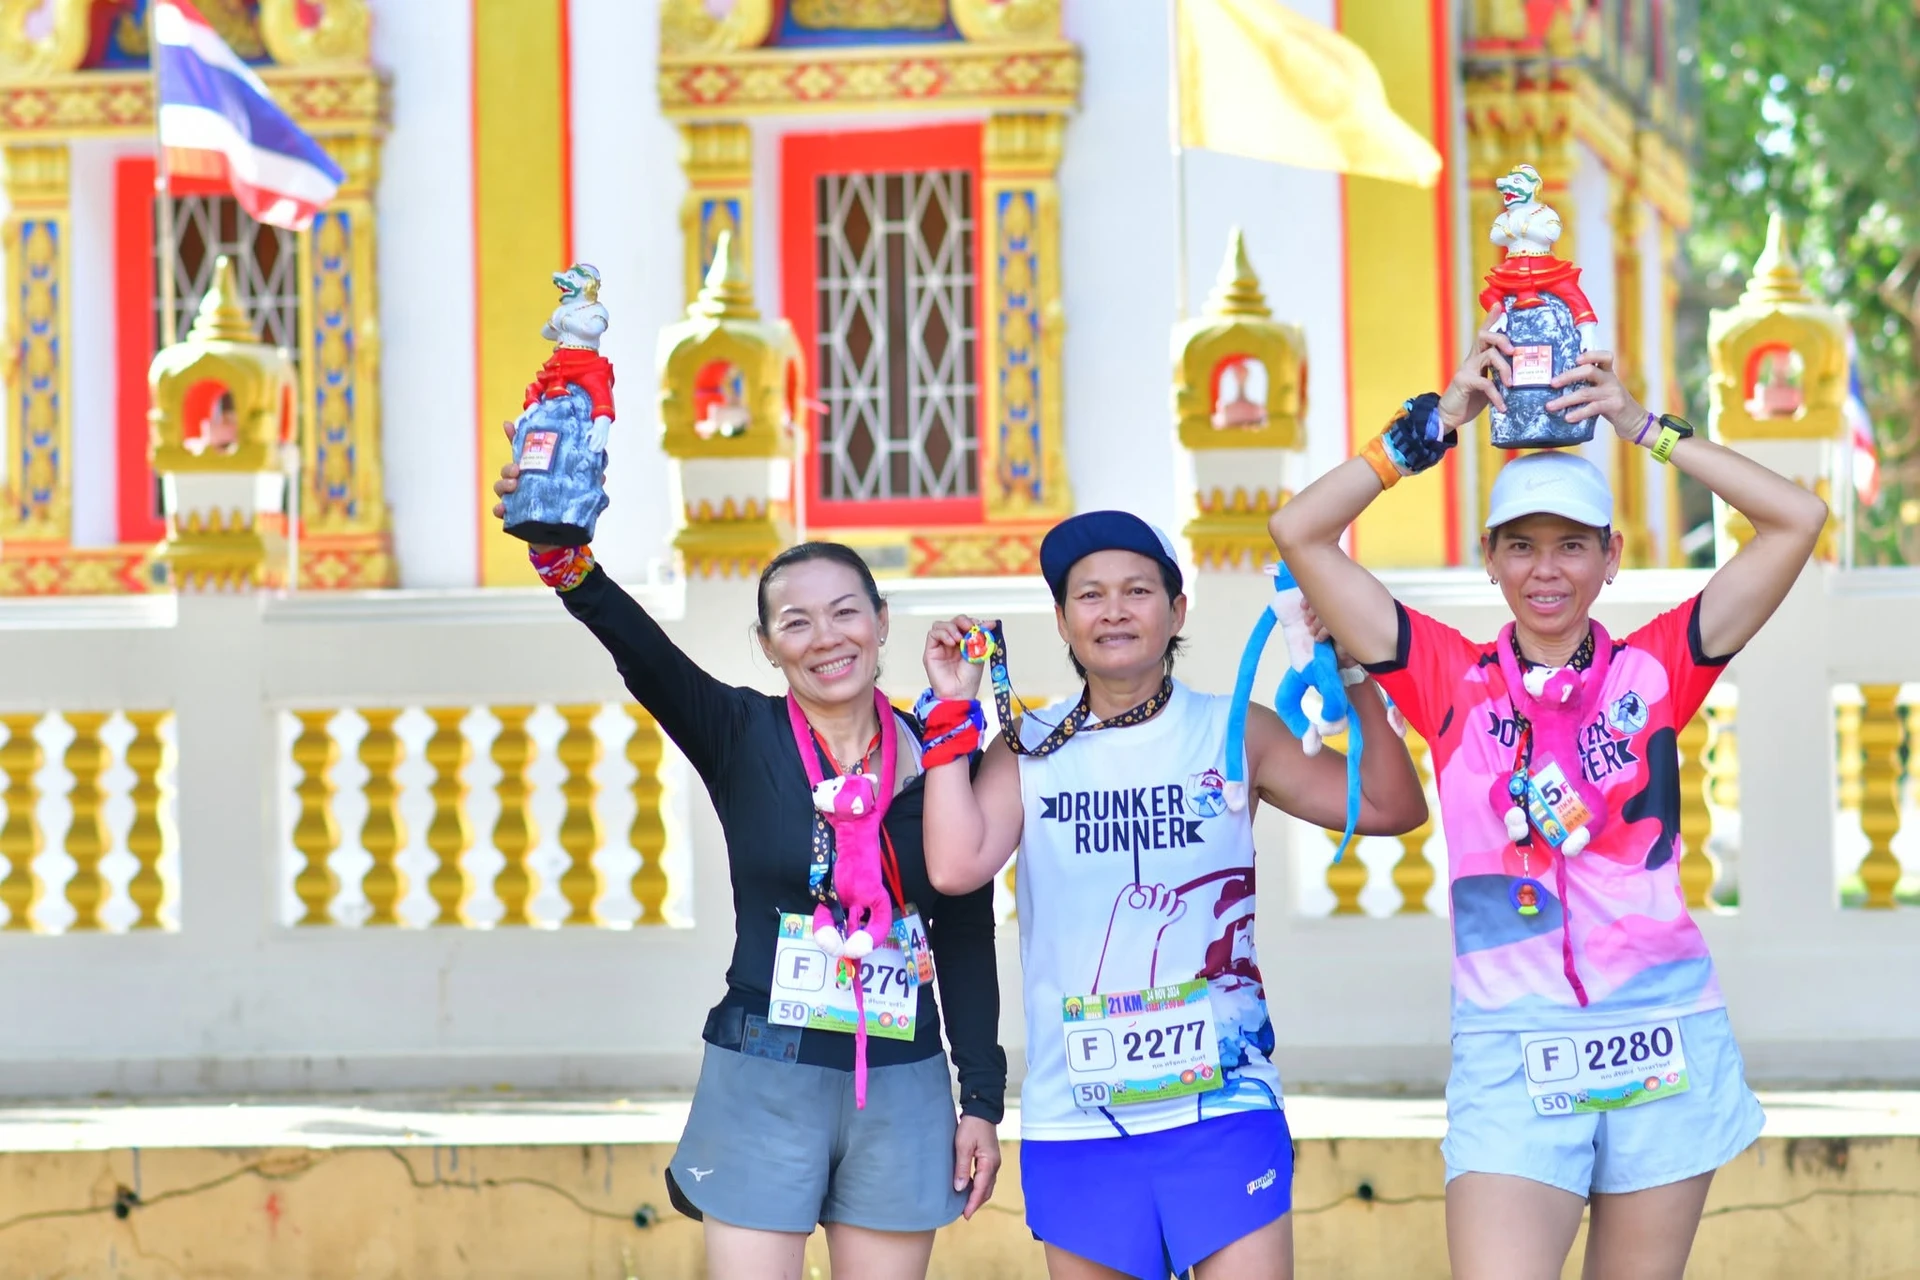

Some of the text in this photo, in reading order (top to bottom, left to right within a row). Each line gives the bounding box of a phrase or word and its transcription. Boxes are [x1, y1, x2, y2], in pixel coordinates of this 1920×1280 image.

[1058, 784, 1185, 823] DRUNKER
[1075, 817, 1187, 854] RUNNER
[792, 956, 811, 979] F
[779, 1003, 805, 1020] 50
[1107, 996, 1122, 1015] 21
[1122, 994, 1143, 1013] KM
[1082, 1036, 1098, 1061] F
[1123, 1020, 1205, 1062] 2277
[1585, 1026, 1673, 1071] 2280
[1542, 1046, 1559, 1072] F
[1081, 1085, 1106, 1101] 50
[1542, 1095, 1567, 1111] 50
